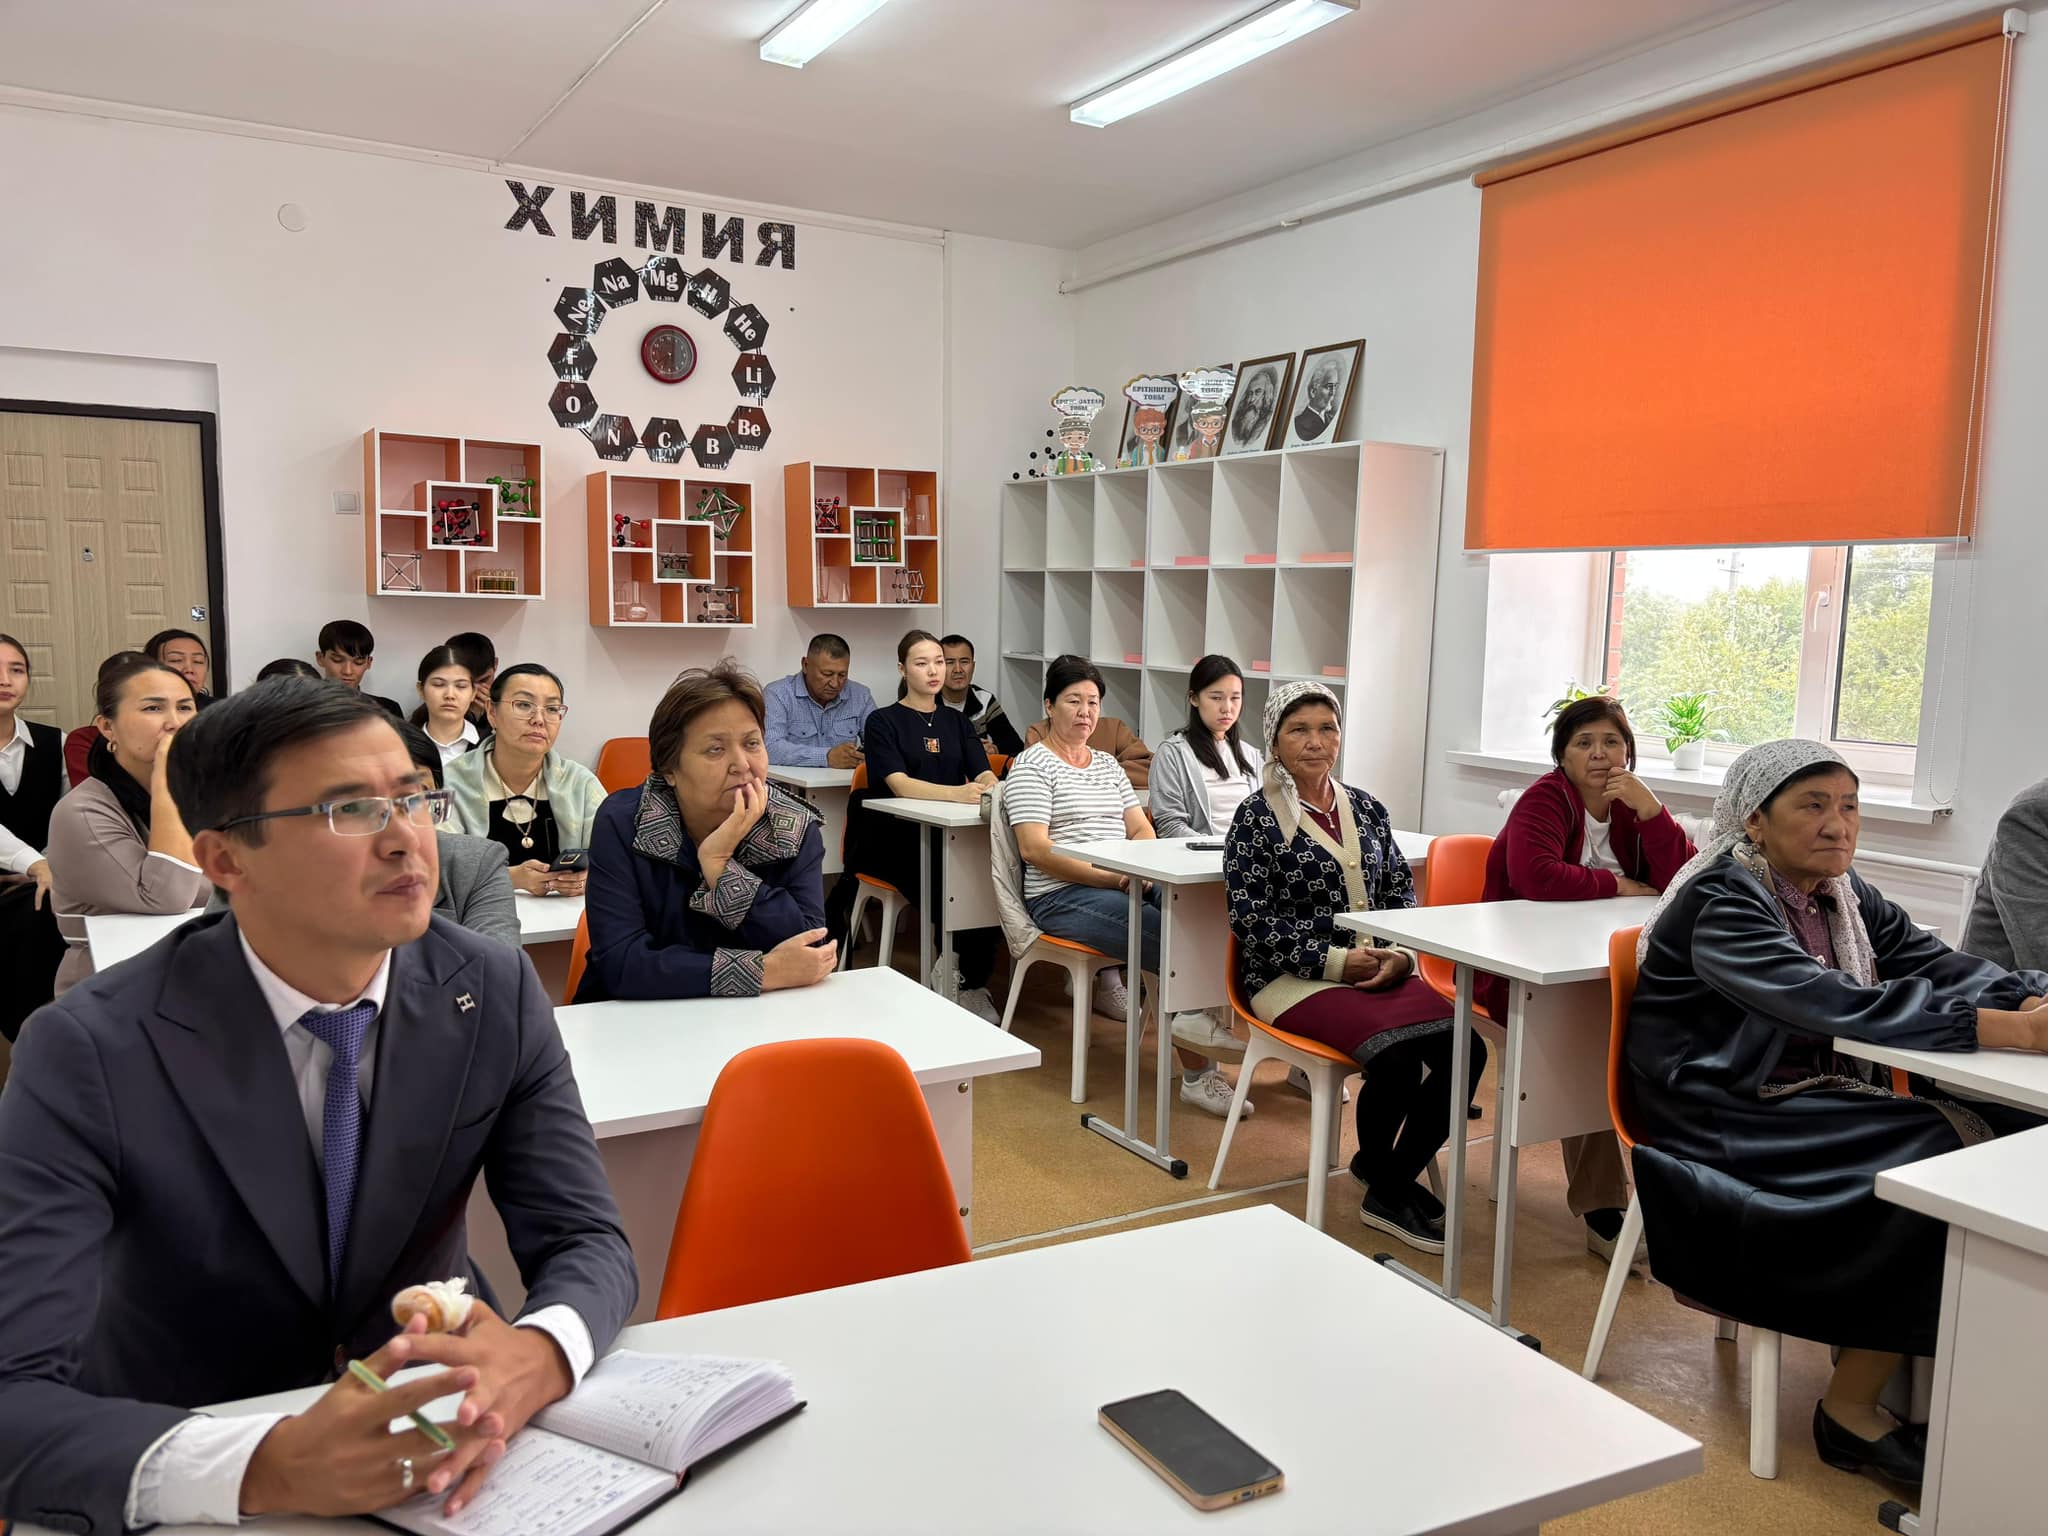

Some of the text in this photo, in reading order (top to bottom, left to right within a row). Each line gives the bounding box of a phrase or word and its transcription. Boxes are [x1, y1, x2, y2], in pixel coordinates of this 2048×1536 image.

[504, 179, 795, 270] ХИМИЯ
[602, 274, 631, 294] Na
[650, 269, 679, 291] Mg
[567, 300, 590, 325] Ne
[734, 313, 757, 341] He
[567, 347, 579, 365] F
[746, 367, 762, 383] Li
[566, 396, 581, 413] O
[738, 419, 761, 437] Be
[607, 429, 621, 446] N
[658, 432, 671, 448] C
[706, 438, 720, 454] B
